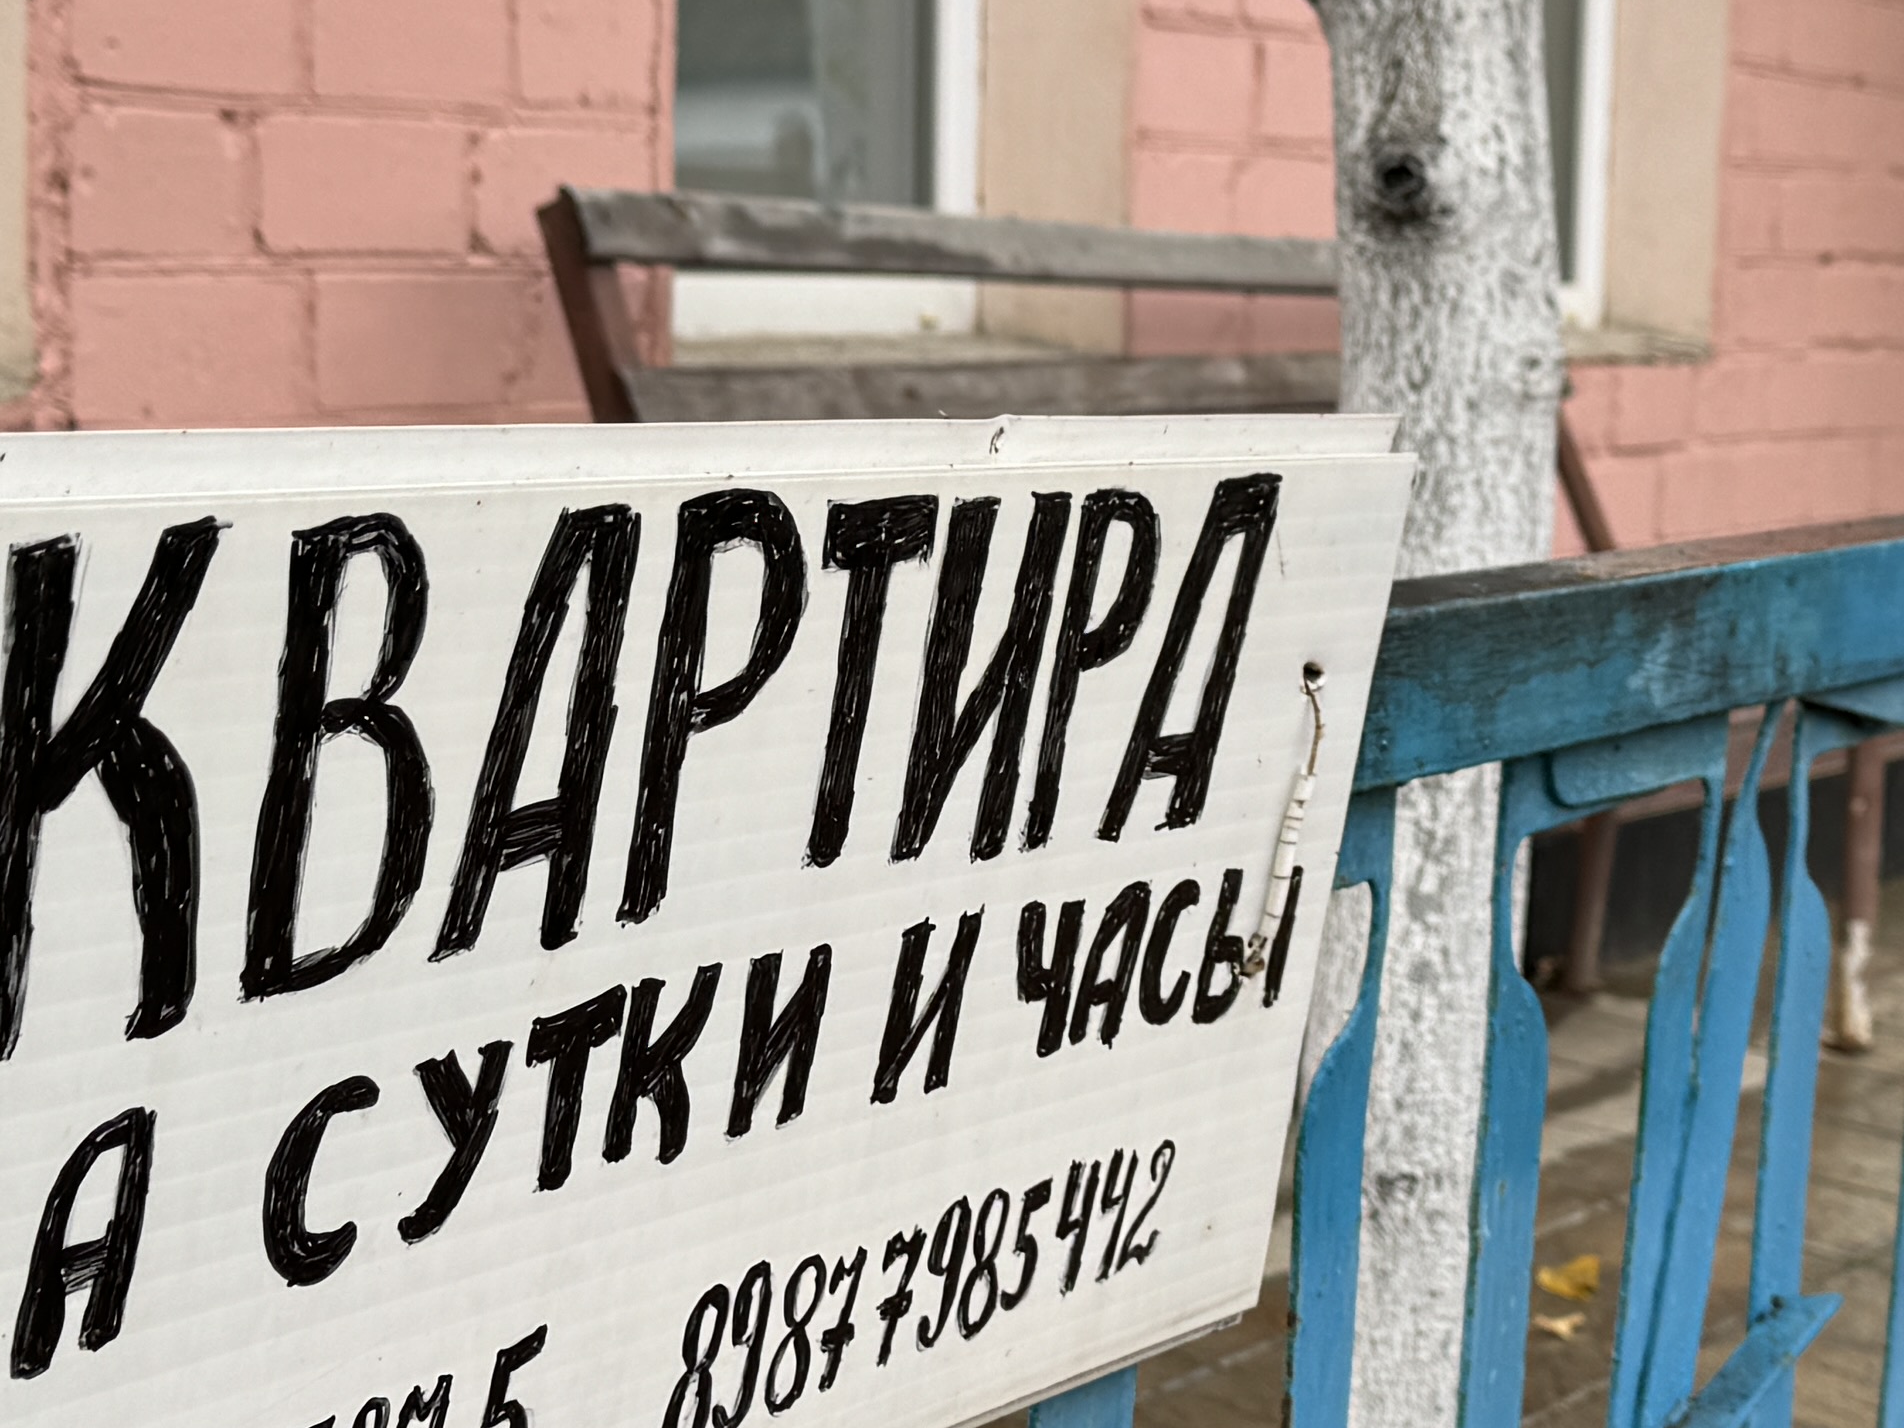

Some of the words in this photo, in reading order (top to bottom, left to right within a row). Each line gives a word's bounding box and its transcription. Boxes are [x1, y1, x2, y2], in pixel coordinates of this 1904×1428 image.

[261, 942, 834, 1289] СУТКИ
[868, 903, 986, 1106] И
[1015, 864, 1305, 1059] ЧАСЫ
